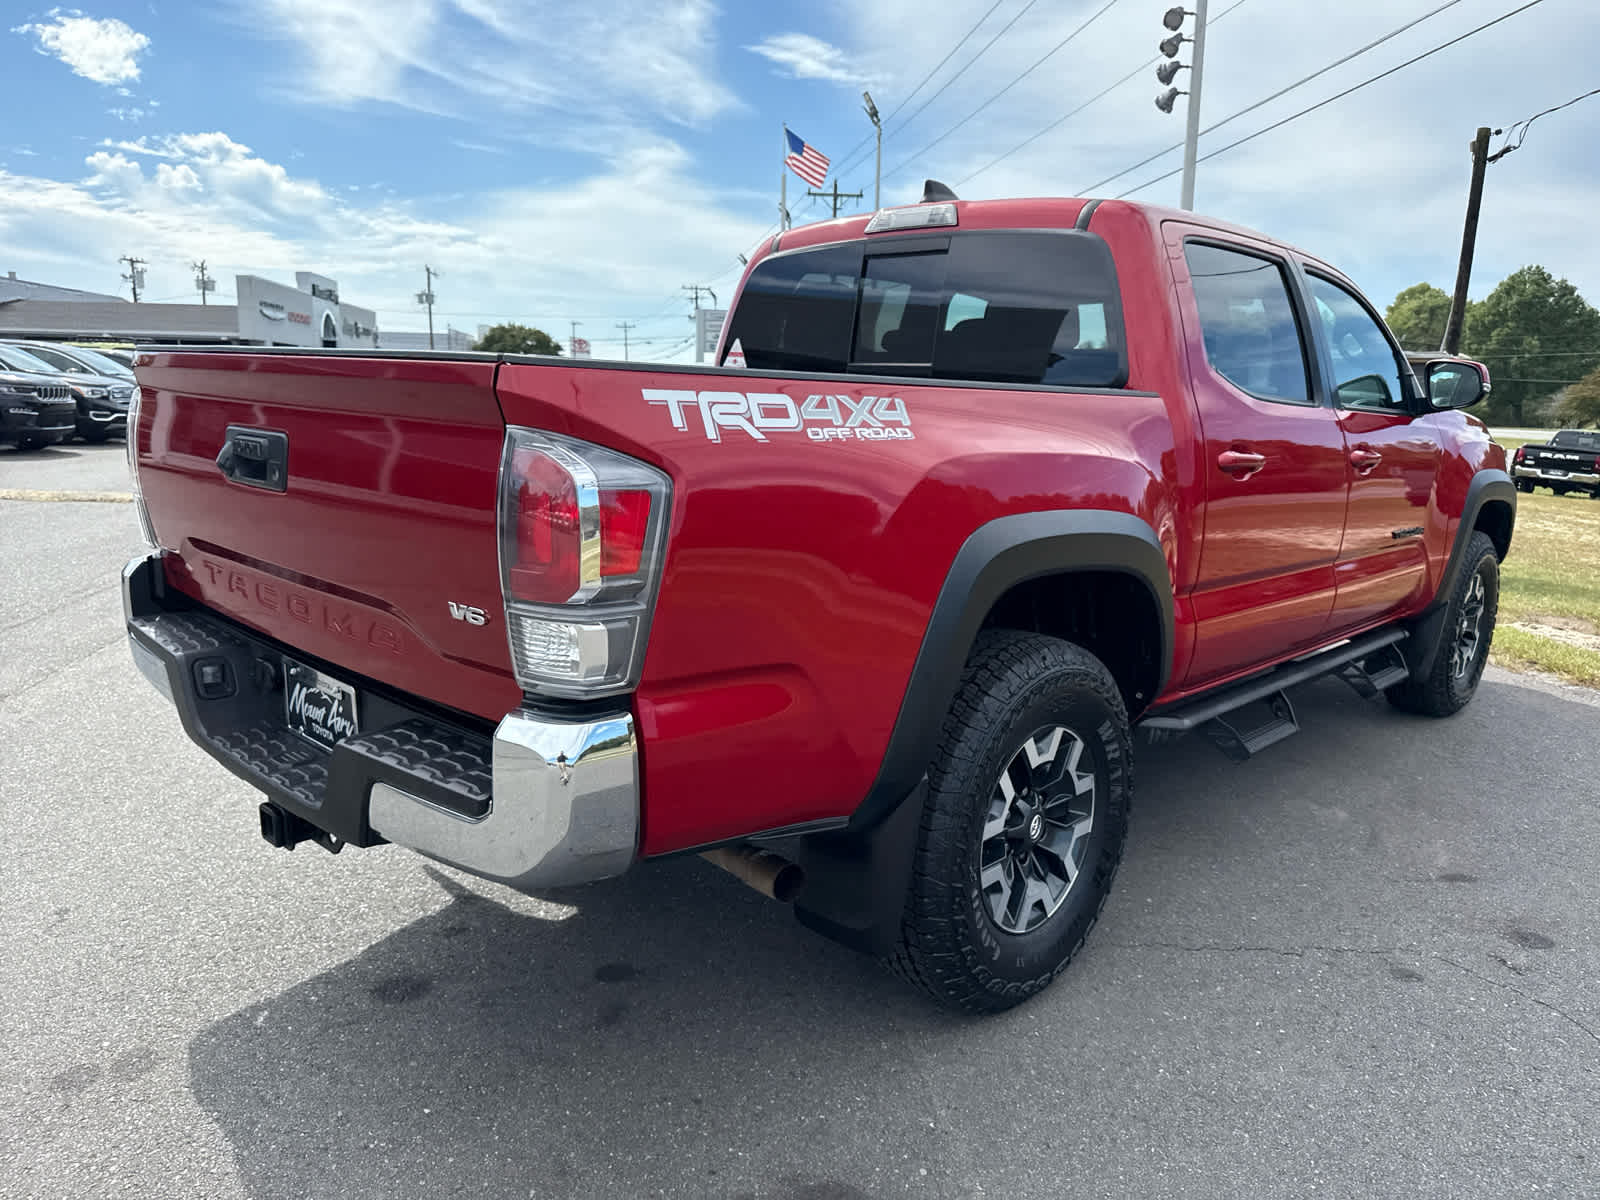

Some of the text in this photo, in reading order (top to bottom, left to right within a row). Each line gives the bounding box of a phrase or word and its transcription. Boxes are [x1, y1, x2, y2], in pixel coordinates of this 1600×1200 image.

[641, 388, 912, 443] TRD 4X4
[806, 427, 916, 442] OFF ROAD
[202, 559, 403, 655] TACOMA
[447, 600, 487, 626] V6
